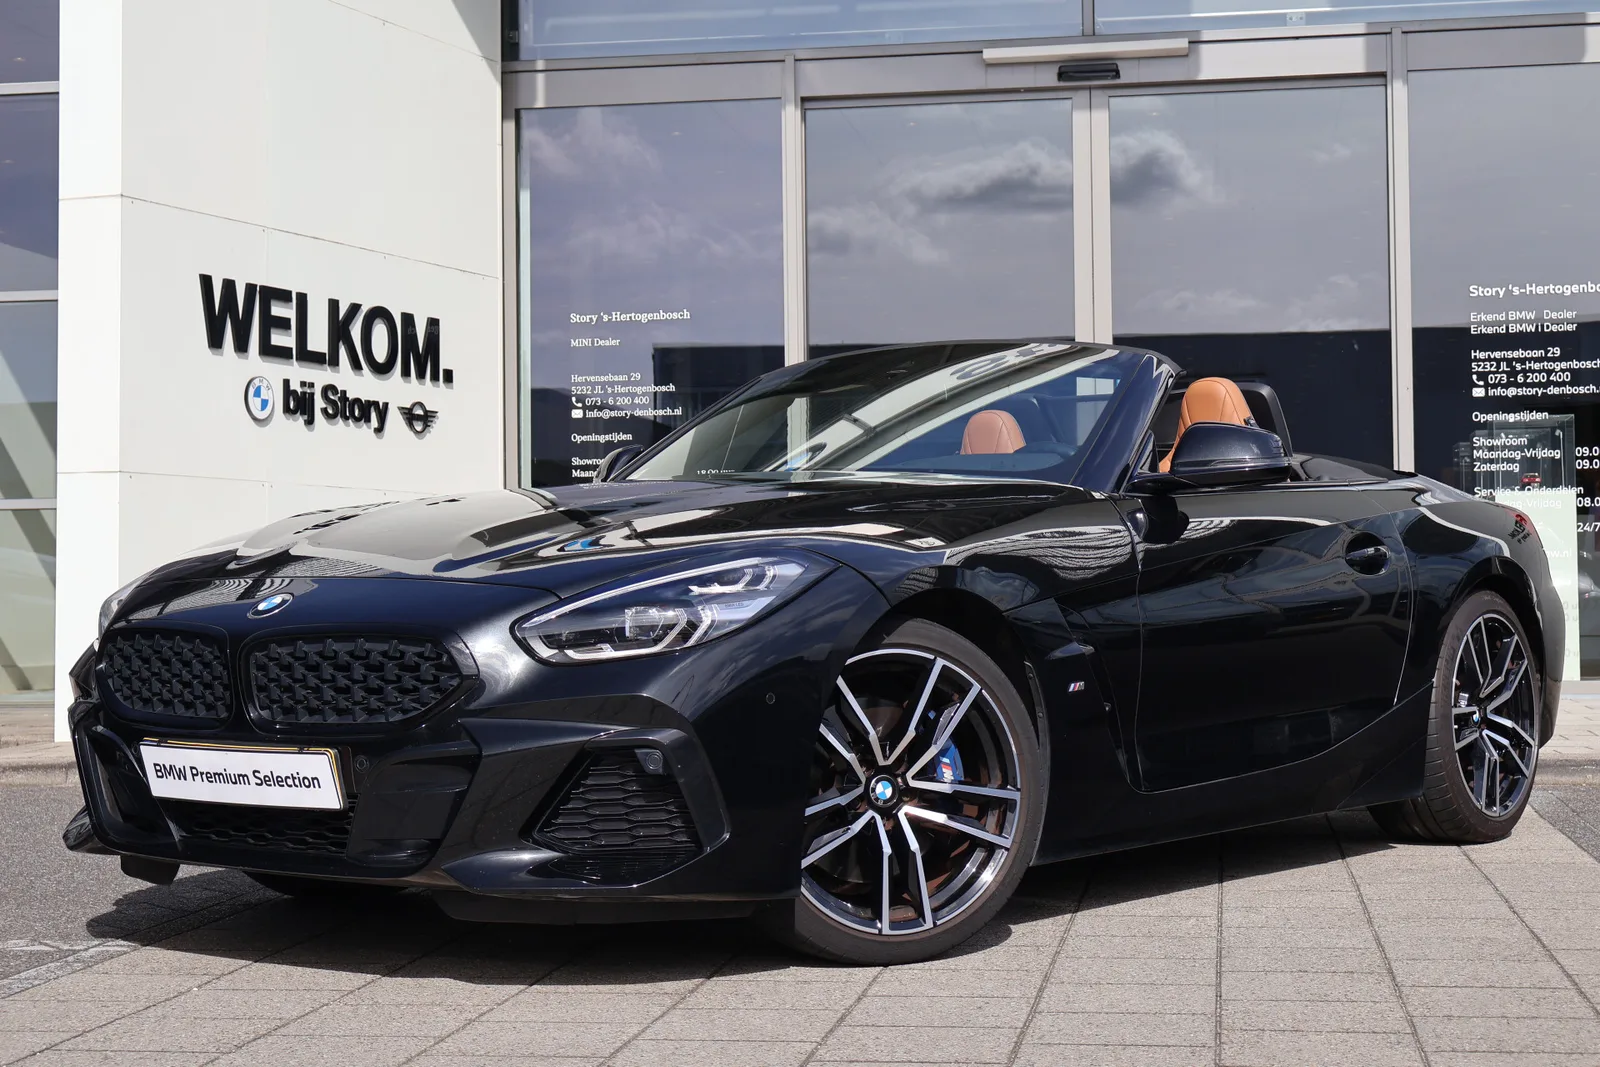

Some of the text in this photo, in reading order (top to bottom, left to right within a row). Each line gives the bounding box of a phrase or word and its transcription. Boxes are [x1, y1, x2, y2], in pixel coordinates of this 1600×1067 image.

[1469, 285, 1506, 298] Story
[570, 309, 691, 325] Story 's-Hertogenbosch
[1470, 309, 1578, 322] Erkend BMW Dealer
[199, 273, 453, 384] WELKOM.
[1470, 324, 1506, 335] Erkend
[1508, 323, 1536, 334] BMW
[1543, 322, 1578, 333] Dealer
[570, 337, 620, 347] MINI Dealer
[1471, 347, 1561, 360] Hervensebaan 29
[1471, 361, 1497, 372] 5232
[1498, 361, 1511, 371] JL
[571, 372, 641, 383] Hervensebaan 29
[1487, 373, 1507, 384] 073
[1516, 373, 1524, 383] 6
[1526, 373, 1547, 383] 200
[1549, 371, 1571, 382] 400
[571, 383, 676, 395] 5232 JL 's-Hertogenbosch
[1488, 384, 1600, 397] info@story-denbosch.
[283, 378, 389, 434] bij Story
[585, 397, 601, 406] 073
[608, 397, 614, 405] 6
[615, 396, 632, 405] 200
[633, 396, 650, 405] 400
[586, 407, 682, 419] info@story-denbosch.nl
[1472, 411, 1549, 422] Openingstijden
[571, 432, 633, 443] Openingstijden
[1472, 437, 1528, 447] Showroom
[1473, 446, 1600, 460] Maandag-Vrijdag 09.0
[1473, 459, 1600, 472] Zaterdag 09.0
[1474, 486, 1511, 498] Service
[1524, 485, 1584, 496] Onderdelen
[1576, 497, 1600, 507] 08.0
[153, 762, 321, 789] BMW Premium Selection
